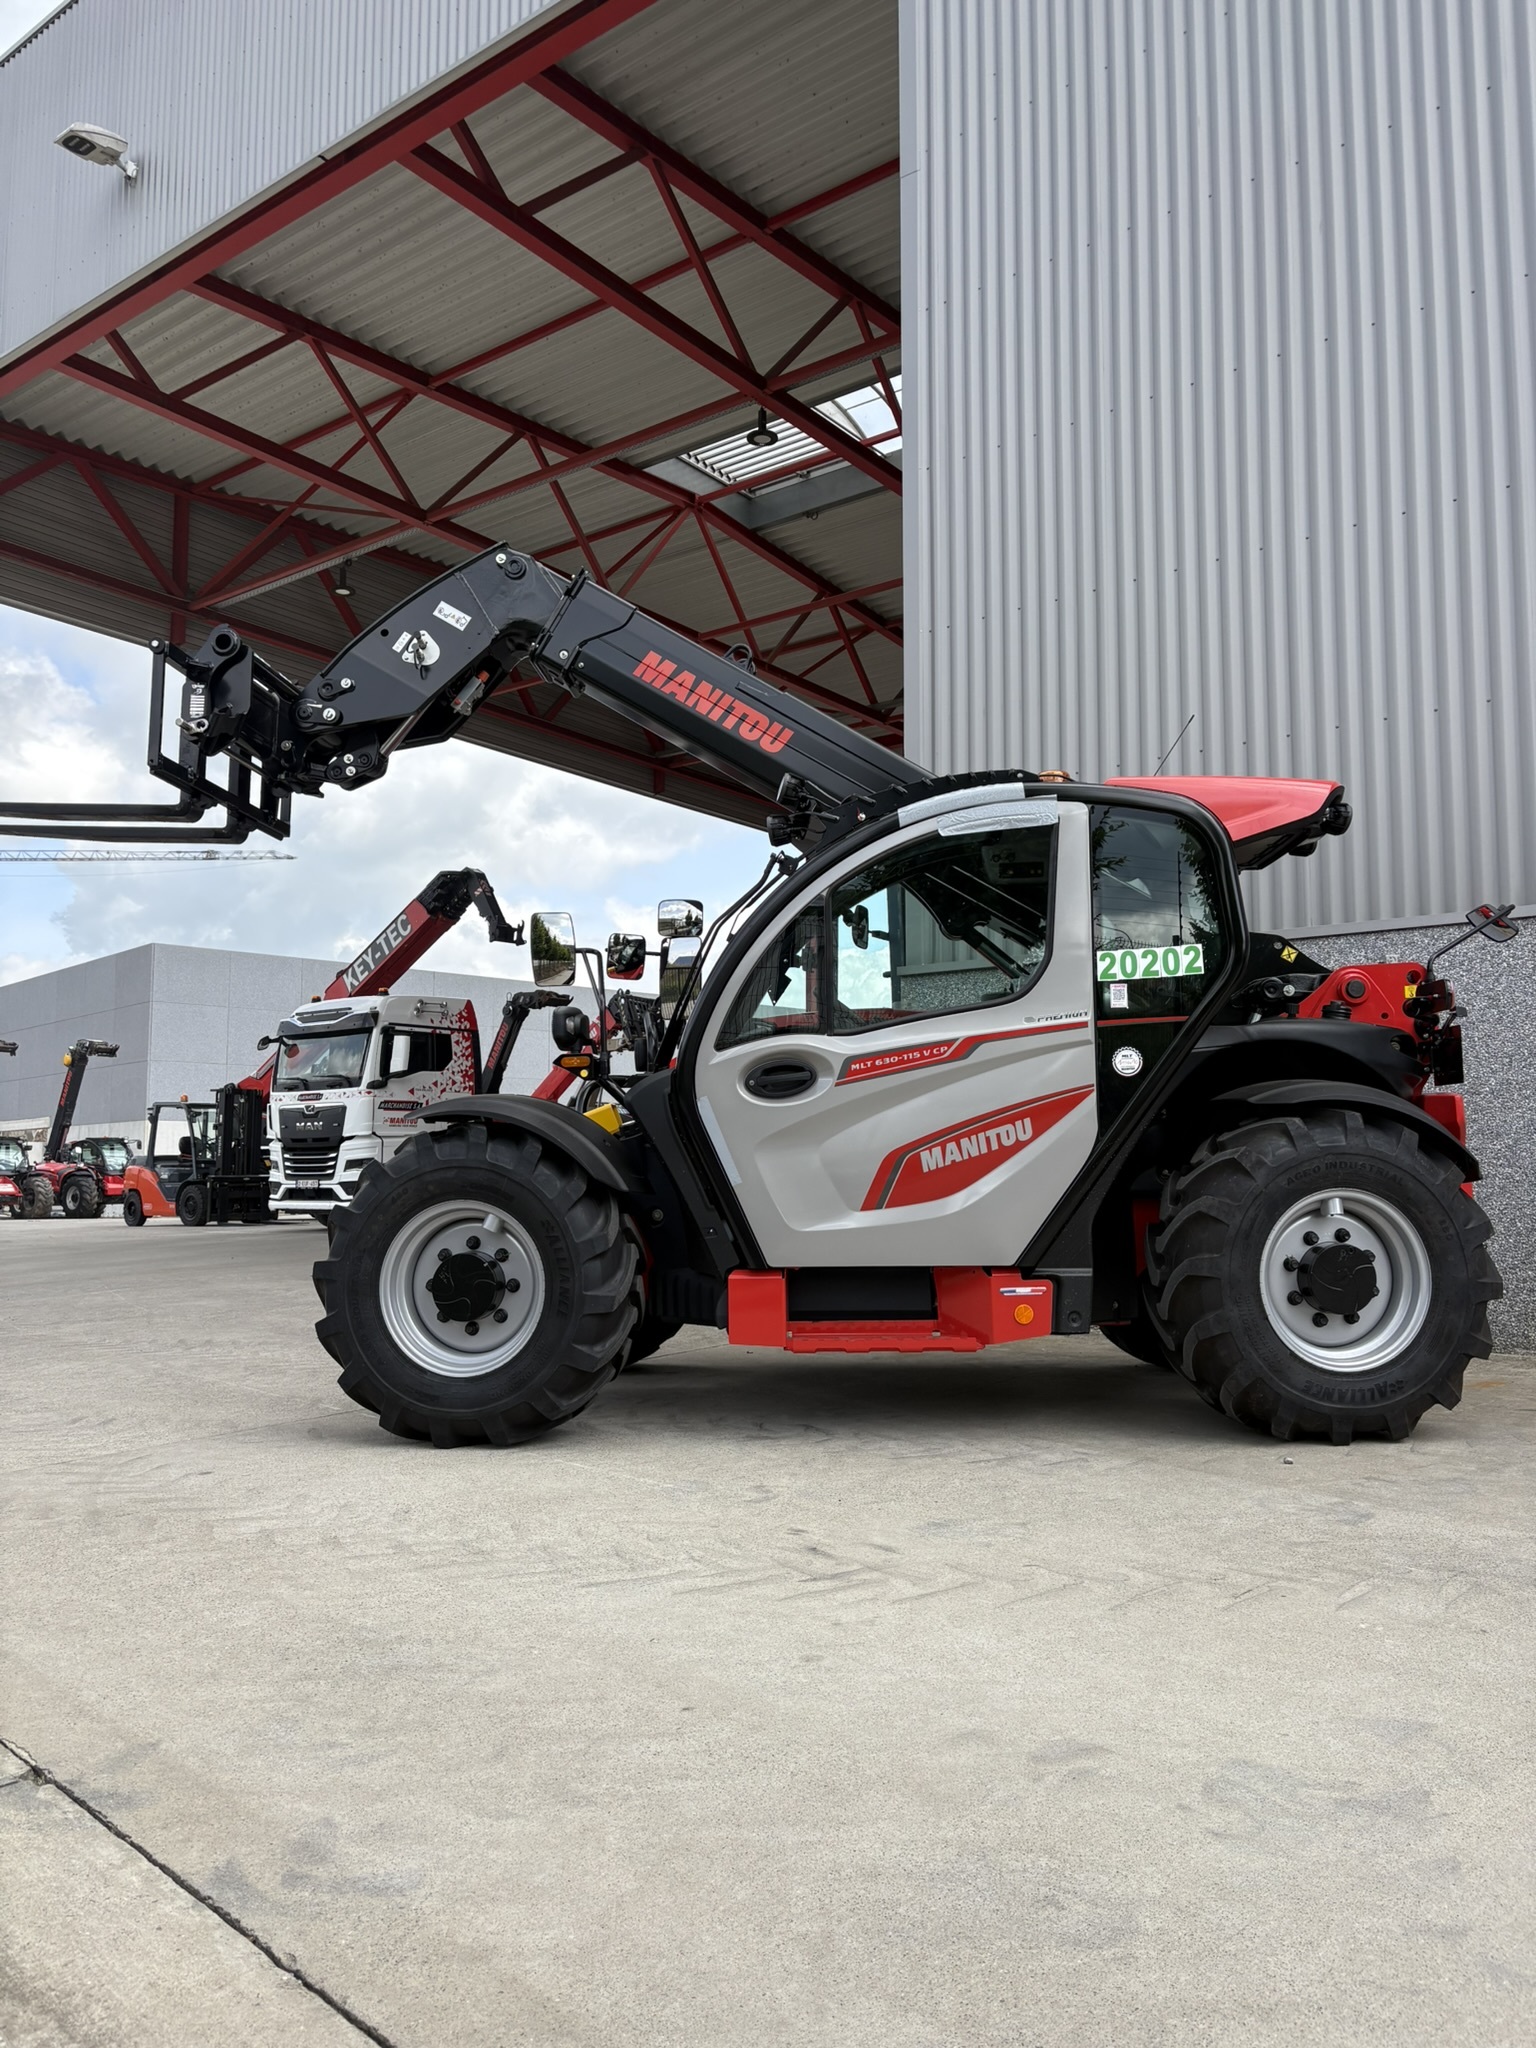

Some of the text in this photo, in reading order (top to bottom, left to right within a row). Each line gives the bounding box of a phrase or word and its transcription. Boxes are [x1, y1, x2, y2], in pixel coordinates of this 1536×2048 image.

[632, 650, 795, 753] MANITOU
[342, 913, 412, 993] KEY-TEC
[1098, 945, 1203, 980] 20202
[486, 1021, 510, 1070] MANITOU
[850, 1046, 948, 1071] MLT 630-115 V CP
[295, 1121, 323, 1131] MAN
[919, 1117, 1033, 1173] MANITOU
[1302, 1379, 1388, 1399] ALLIANCE
